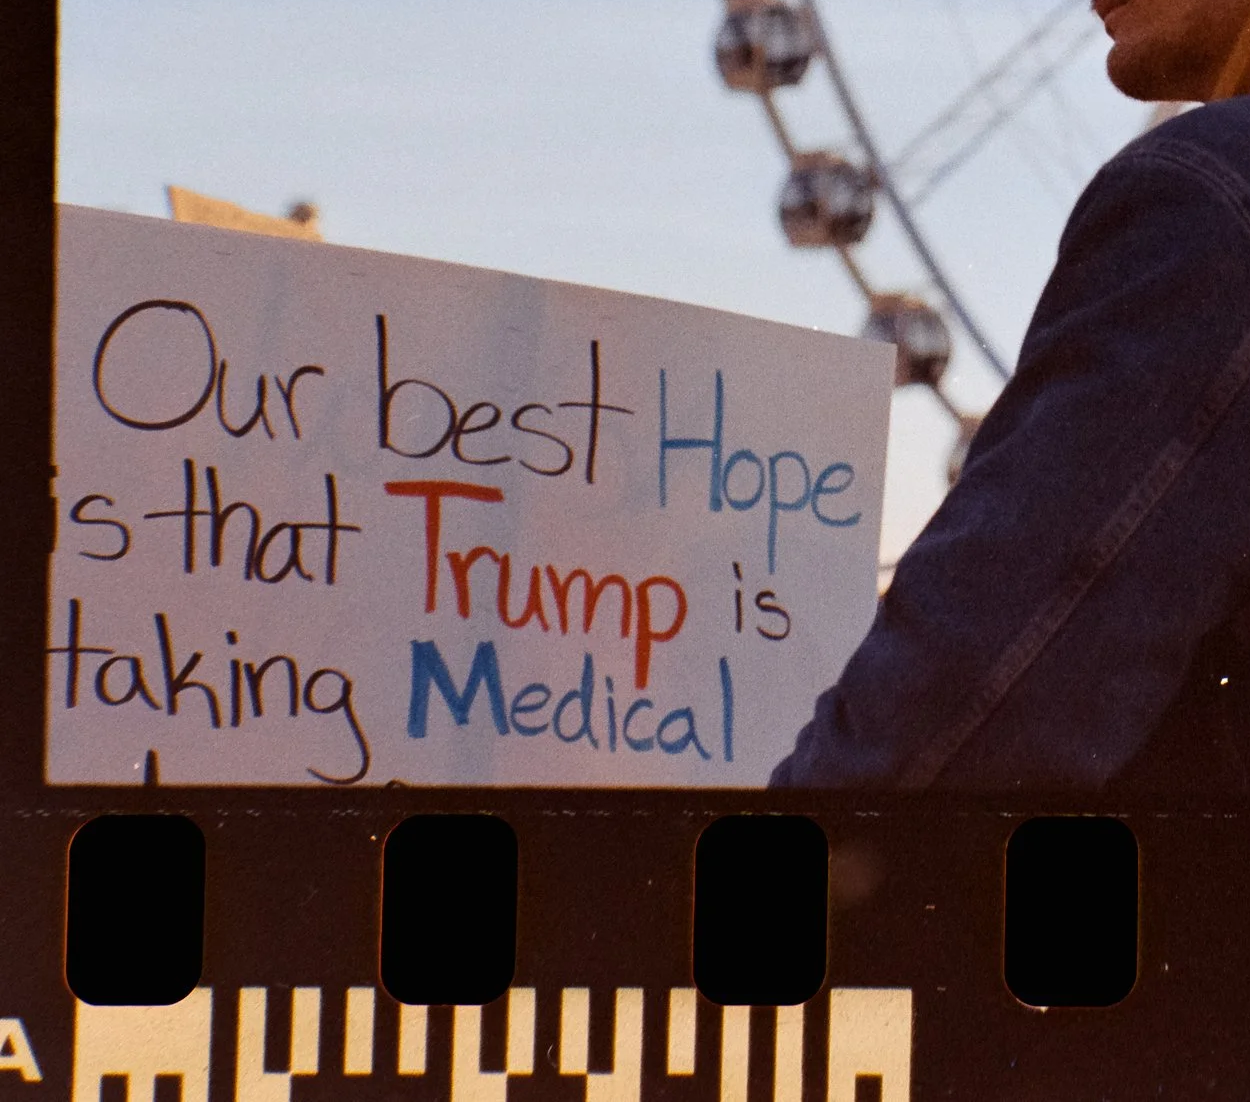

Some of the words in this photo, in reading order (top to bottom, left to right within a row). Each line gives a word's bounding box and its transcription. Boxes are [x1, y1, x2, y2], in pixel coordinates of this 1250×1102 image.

[93, 299, 324, 440] Our
[376, 314, 634, 484] best
[659, 368, 861, 574] Hope
[144, 458, 361, 585] that
[384, 480, 688, 690] Trump
[732, 561, 791, 641] is
[47, 598, 371, 785] taking
[407, 639, 735, 762] Medical
